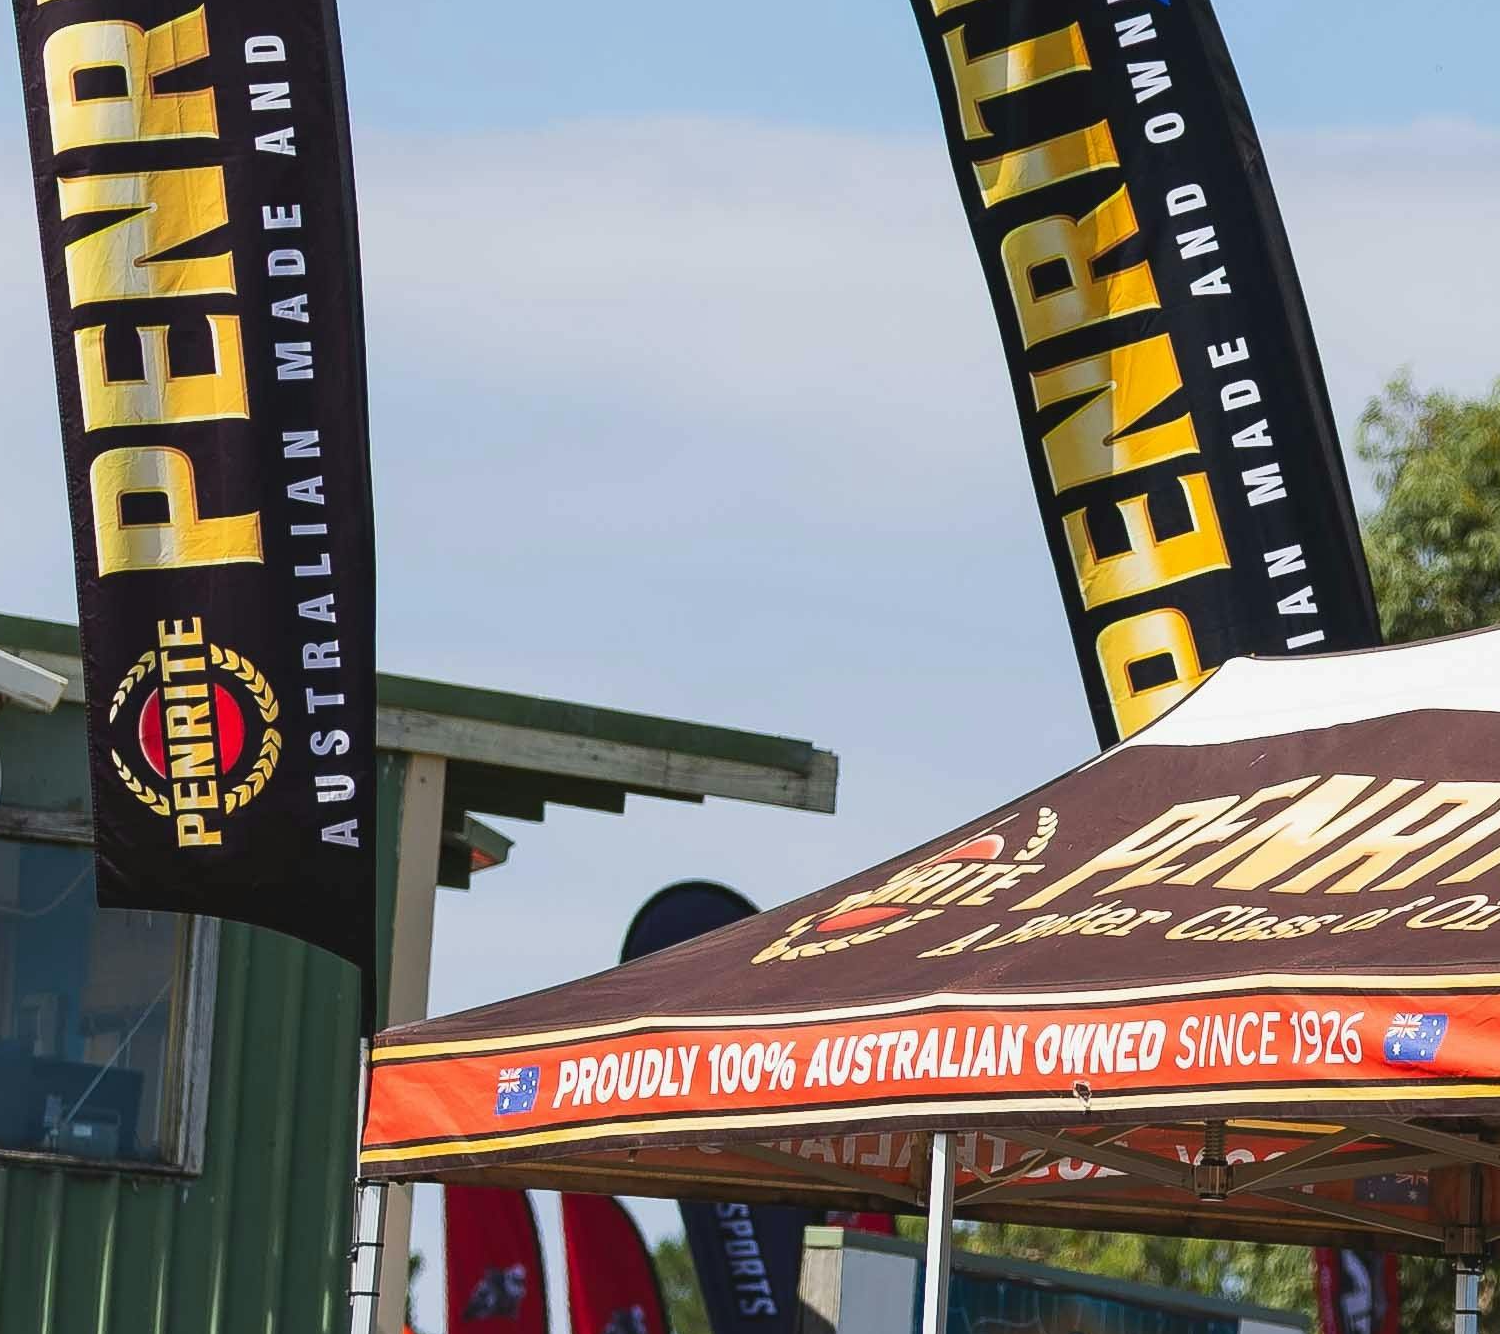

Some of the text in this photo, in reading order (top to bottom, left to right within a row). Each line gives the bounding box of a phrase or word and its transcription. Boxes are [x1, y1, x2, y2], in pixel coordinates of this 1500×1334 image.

[244, 32, 298, 157] AND
[262, 202, 316, 381] MADE
[1164, 180, 1233, 299] AND
[1205, 334, 1289, 507] MADE
[283, 427, 362, 850] AUSTRALIAN
[156, 614, 223, 850] PENRITE
[916, 923, 1002, 960] A
[974, 897, 1172, 953] Better
[1164, 904, 1342, 942] Class
[1348, 895, 1435, 935] of
[551, 1010, 1365, 1111] PROUDLY 100% AUSTRALIAN OWNED SINCE 1926
[717, 1202, 777, 1316] SPORTS
